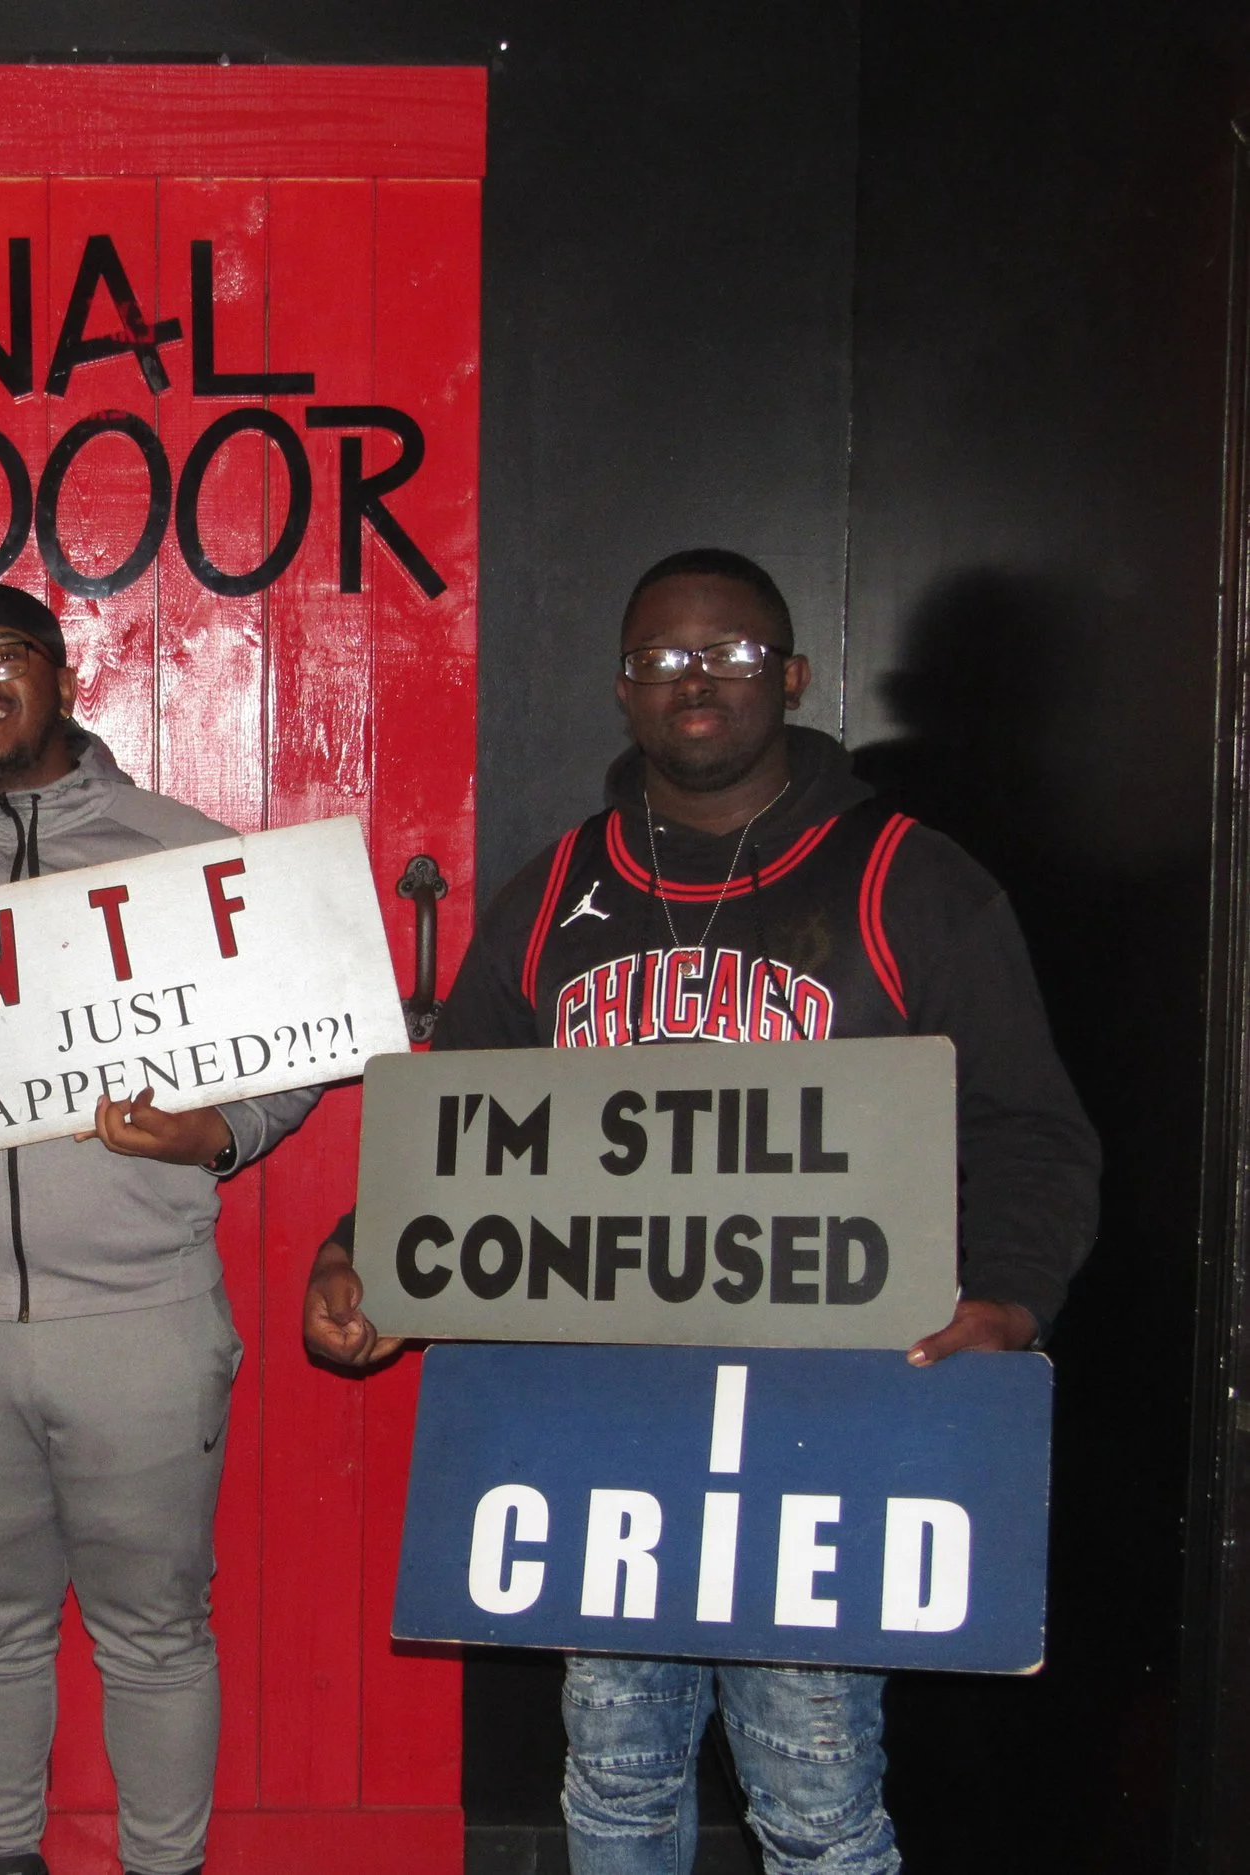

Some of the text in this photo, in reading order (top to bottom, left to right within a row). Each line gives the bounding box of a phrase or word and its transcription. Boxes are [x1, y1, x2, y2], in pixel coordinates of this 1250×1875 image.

[57, 983, 197, 1053] JUST
[553, 947, 834, 1049] CHICAGO
[436, 1086, 849, 1177] I'M STILL
[395, 1214, 889, 1305] CONFUSED
[709, 1365, 748, 1473] I
[468, 1484, 970, 1632] CRIED
